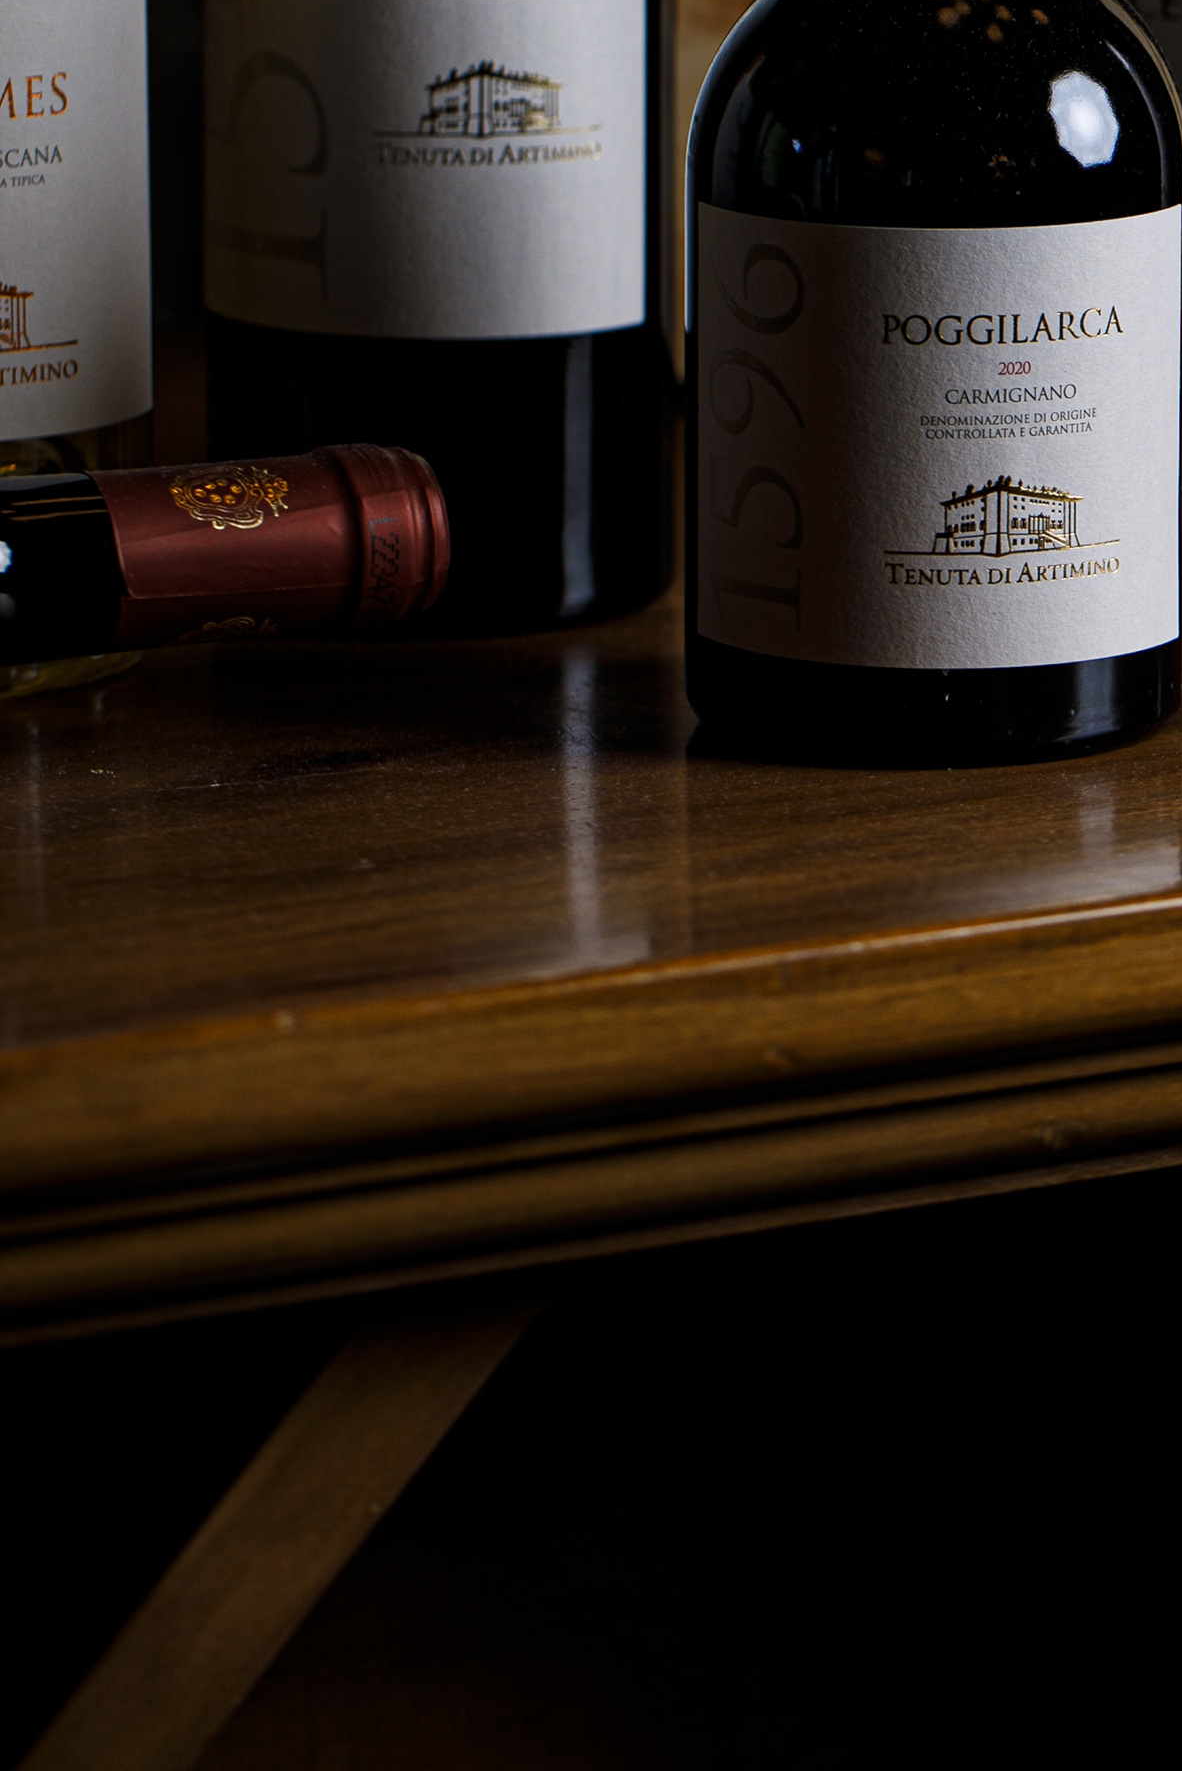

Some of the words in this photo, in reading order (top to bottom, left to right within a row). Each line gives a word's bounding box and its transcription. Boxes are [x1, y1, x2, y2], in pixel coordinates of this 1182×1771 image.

[10, 174, 46, 188] TIPICA
[881, 305, 1125, 346] POGGILARCA
[998, 360, 1031, 376] 2020
[944, 383, 1078, 405] CARMIGNANO
[919, 413, 1030, 427] DENOMINAZIONE
[1033, 412, 1047, 424] DI
[1049, 407, 1097, 423] ORIGINE
[925, 427, 1016, 441] CONTROLLATA
[1020, 427, 1026, 438] E
[1028, 421, 1093, 438] GARANTITA
[884, 562, 981, 586] TENUTA
[988, 567, 1012, 585] DI
[1015, 556, 1121, 585] ARTIMINO
